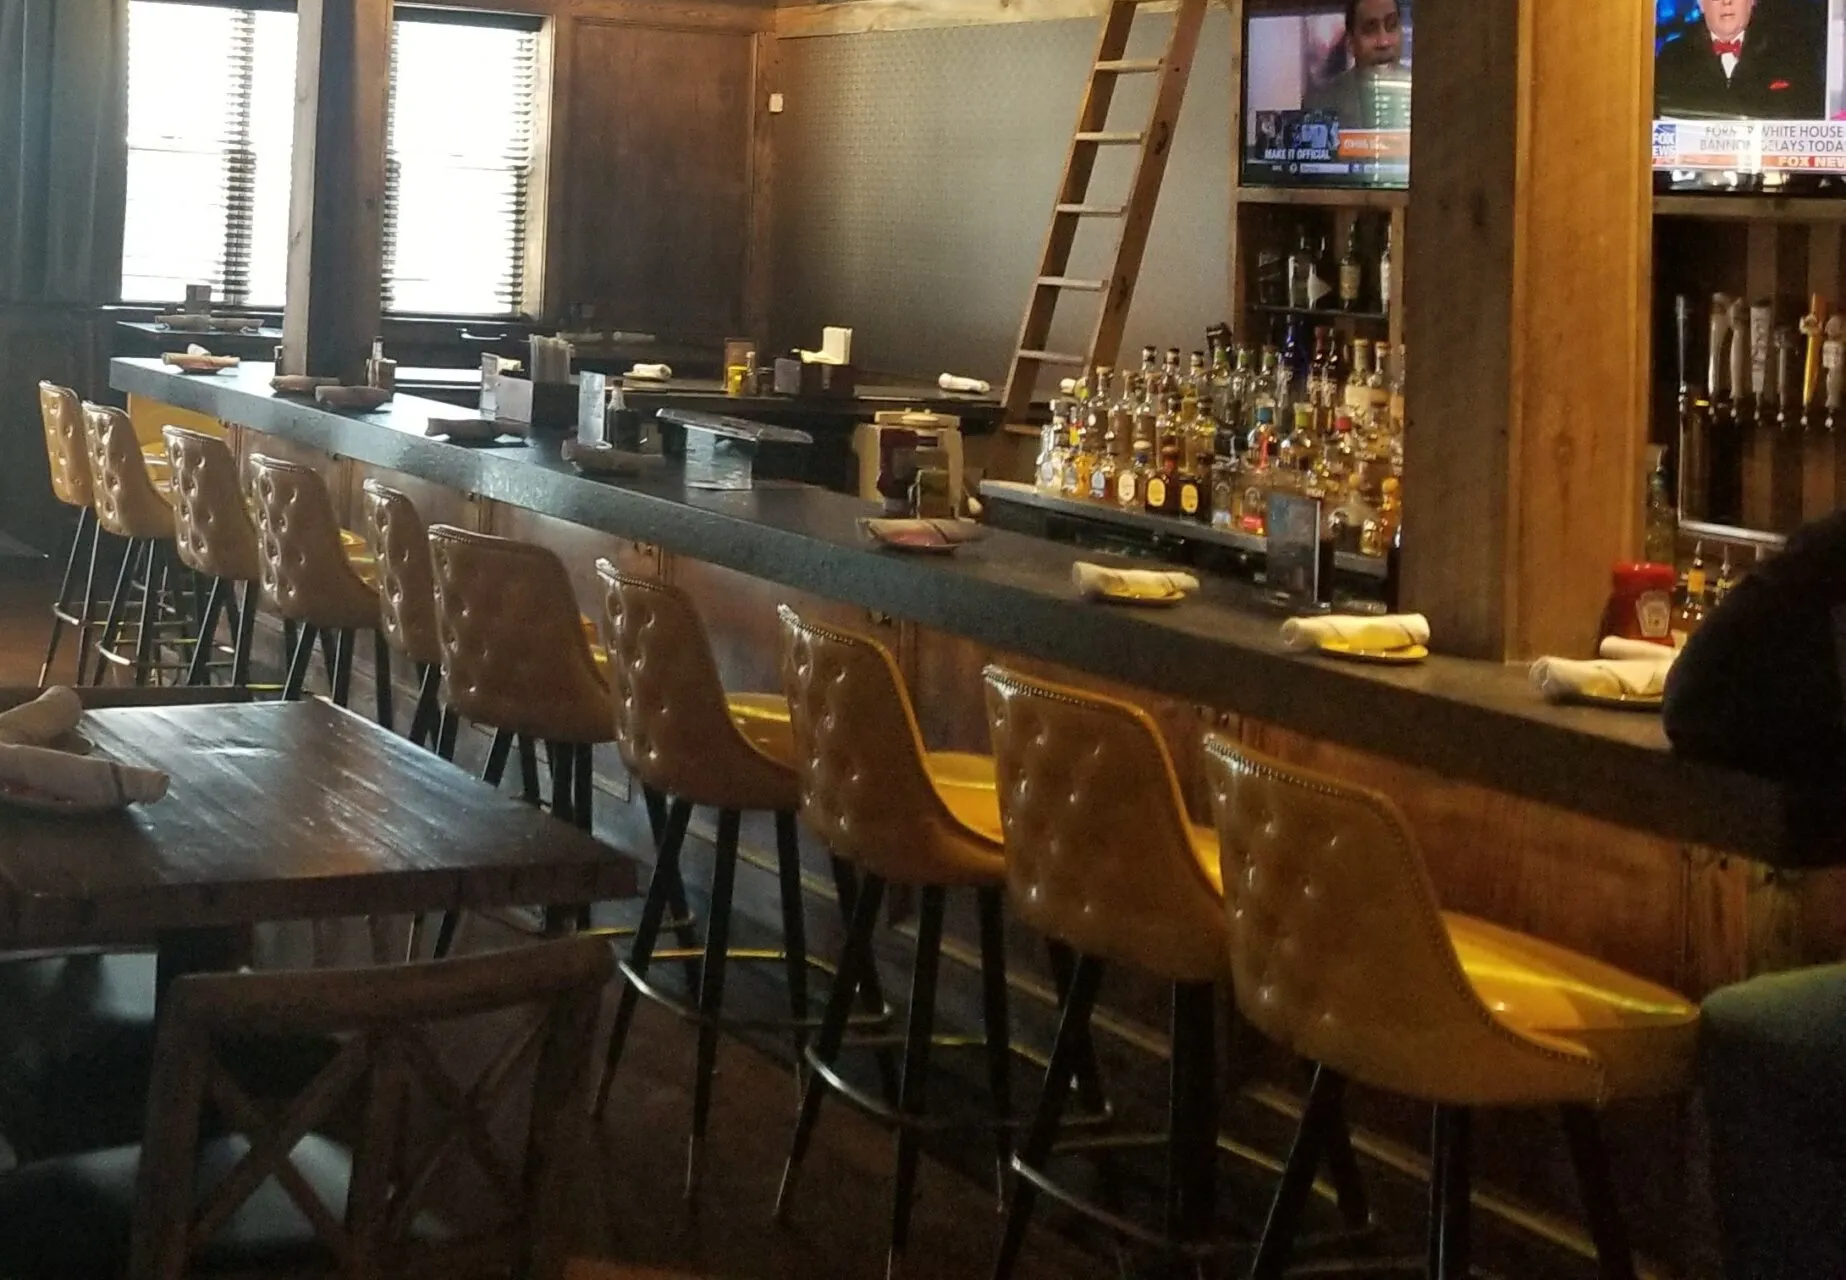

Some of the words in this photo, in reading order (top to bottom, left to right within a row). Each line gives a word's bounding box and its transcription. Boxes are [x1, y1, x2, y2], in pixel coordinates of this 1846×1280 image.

[1800, 125, 1844, 138] HOUSE
[1808, 139, 1846, 152] TODA
[1264, 149, 1286, 160] MAKE
[1288, 148, 1295, 160] IT
[1296, 149, 1330, 160] OFFICIAL
[1777, 156, 1810, 167] FOX
